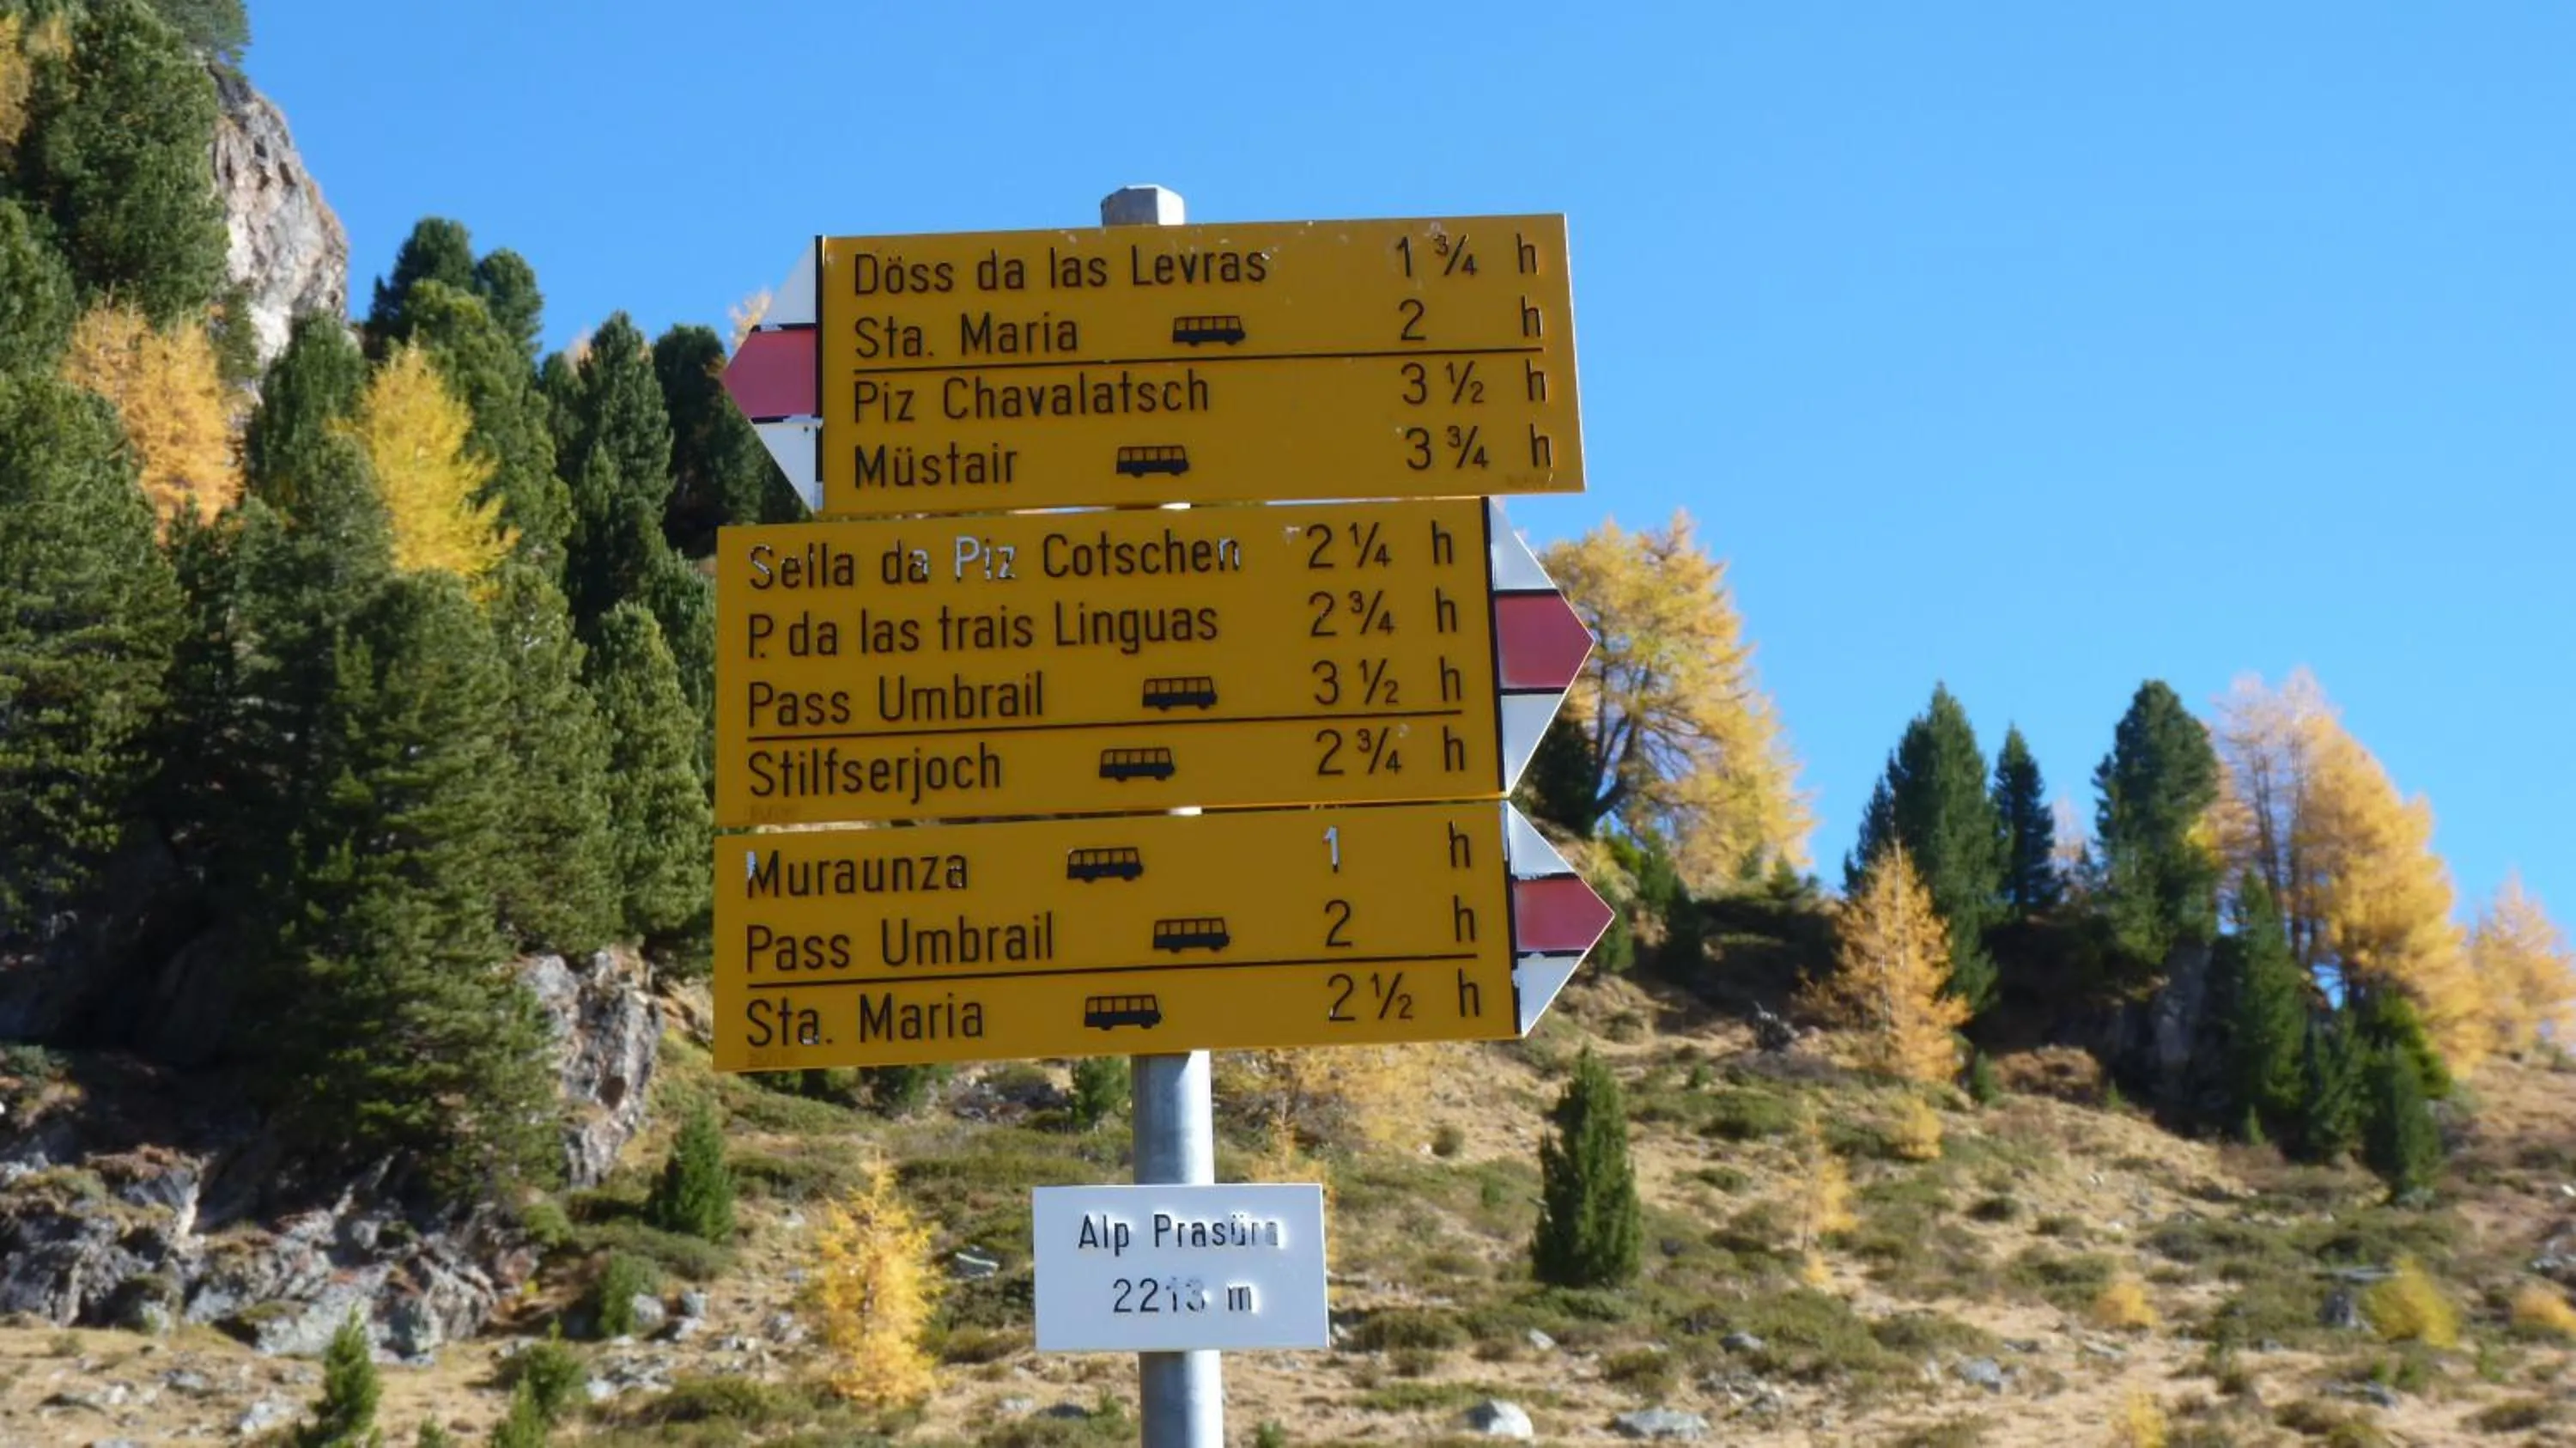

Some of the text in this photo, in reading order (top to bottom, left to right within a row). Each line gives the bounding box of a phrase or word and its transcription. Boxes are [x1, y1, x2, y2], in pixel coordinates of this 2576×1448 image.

[854, 253, 955, 296] Döss
[976, 248, 1025, 292] da
[1049, 246, 1108, 289] las
[1131, 243, 1268, 287] Levras
[1516, 233, 1540, 275] h
[854, 295, 1544, 360] Sta. Maria 2 h
[854, 380, 915, 424] Piz
[943, 368, 1209, 421] Chavalatsch
[1524, 358, 1548, 403] h
[854, 442, 1018, 490] Müstair
[1529, 423, 1553, 468] h
[749, 542, 855, 591] Sella
[881, 540, 932, 586] da
[954, 535, 1018, 584] Piz
[1042, 528, 1241, 579] Cotschen
[1431, 520, 1454, 566] h
[748, 612, 775, 660] P.
[788, 611, 839, 657] da
[860, 608, 920, 655] las
[937, 605, 1034, 652] trais
[1054, 601, 1218, 655] Linguas
[1435, 587, 1458, 634] h
[748, 681, 851, 729] Pass
[878, 670, 1045, 721] Umbrail
[1439, 655, 1461, 703] h
[747, 742, 1001, 805] Stilfserjoch
[1442, 725, 1467, 772] h
[745, 821, 1472, 899] Muraunza 1 h
[746, 894, 1477, 974] Pass Umbrail 2 h
[745, 996, 833, 1049] Sta.
[859, 992, 983, 1043] Maria
[1457, 968, 1481, 1018] h
[1078, 1214, 1130, 1258] Alp
[1227, 1287, 1252, 1311] m
